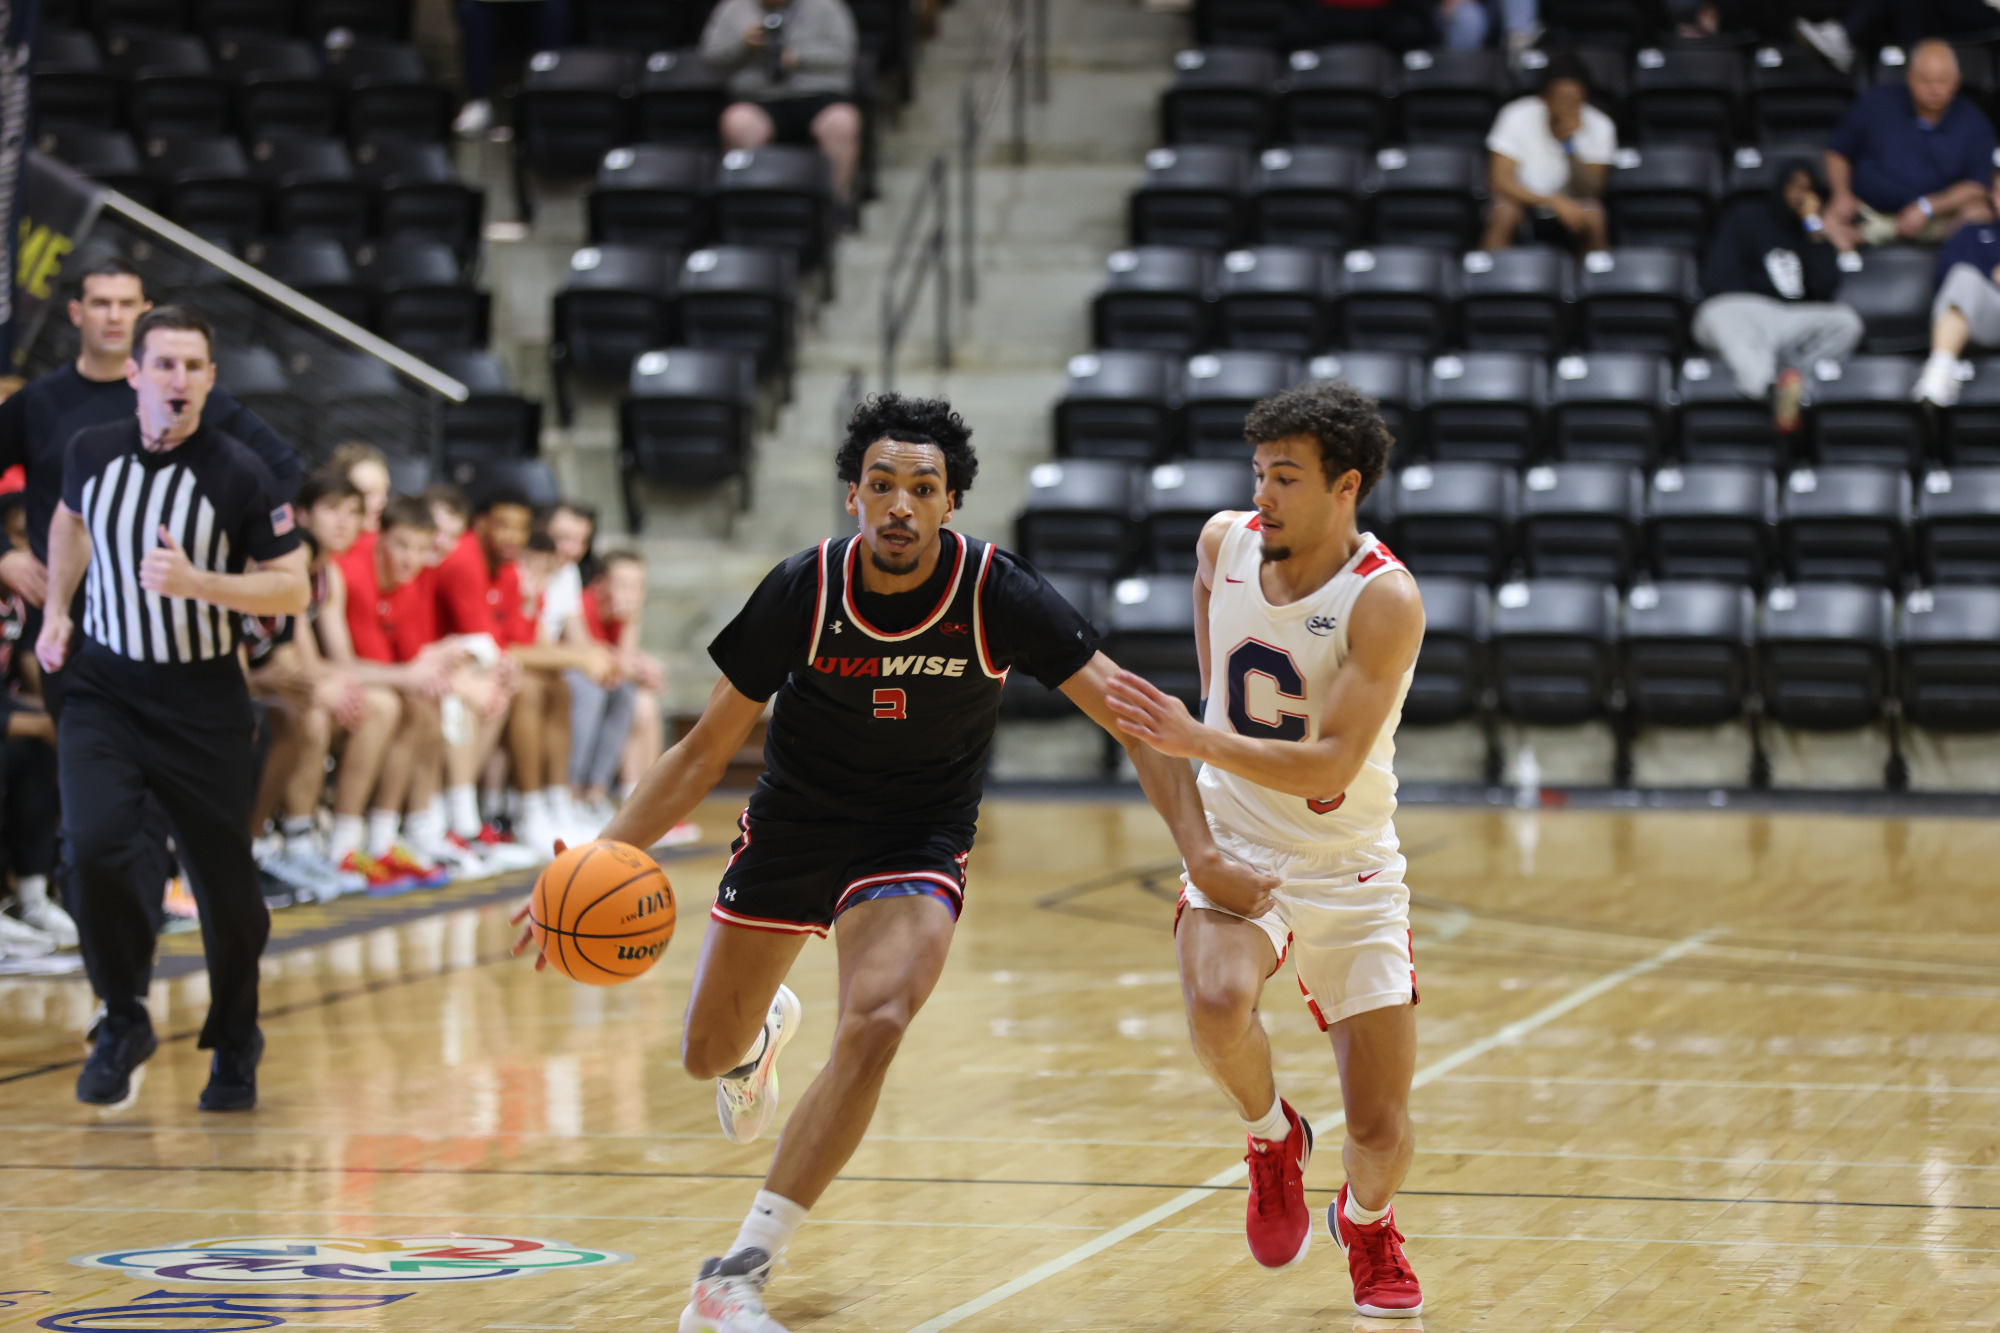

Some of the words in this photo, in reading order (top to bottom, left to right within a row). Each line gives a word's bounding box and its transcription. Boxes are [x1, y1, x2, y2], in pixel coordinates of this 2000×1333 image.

[943, 621, 969, 634] SAC
[1310, 615, 1336, 629] SAC
[1224, 636, 1310, 743] C
